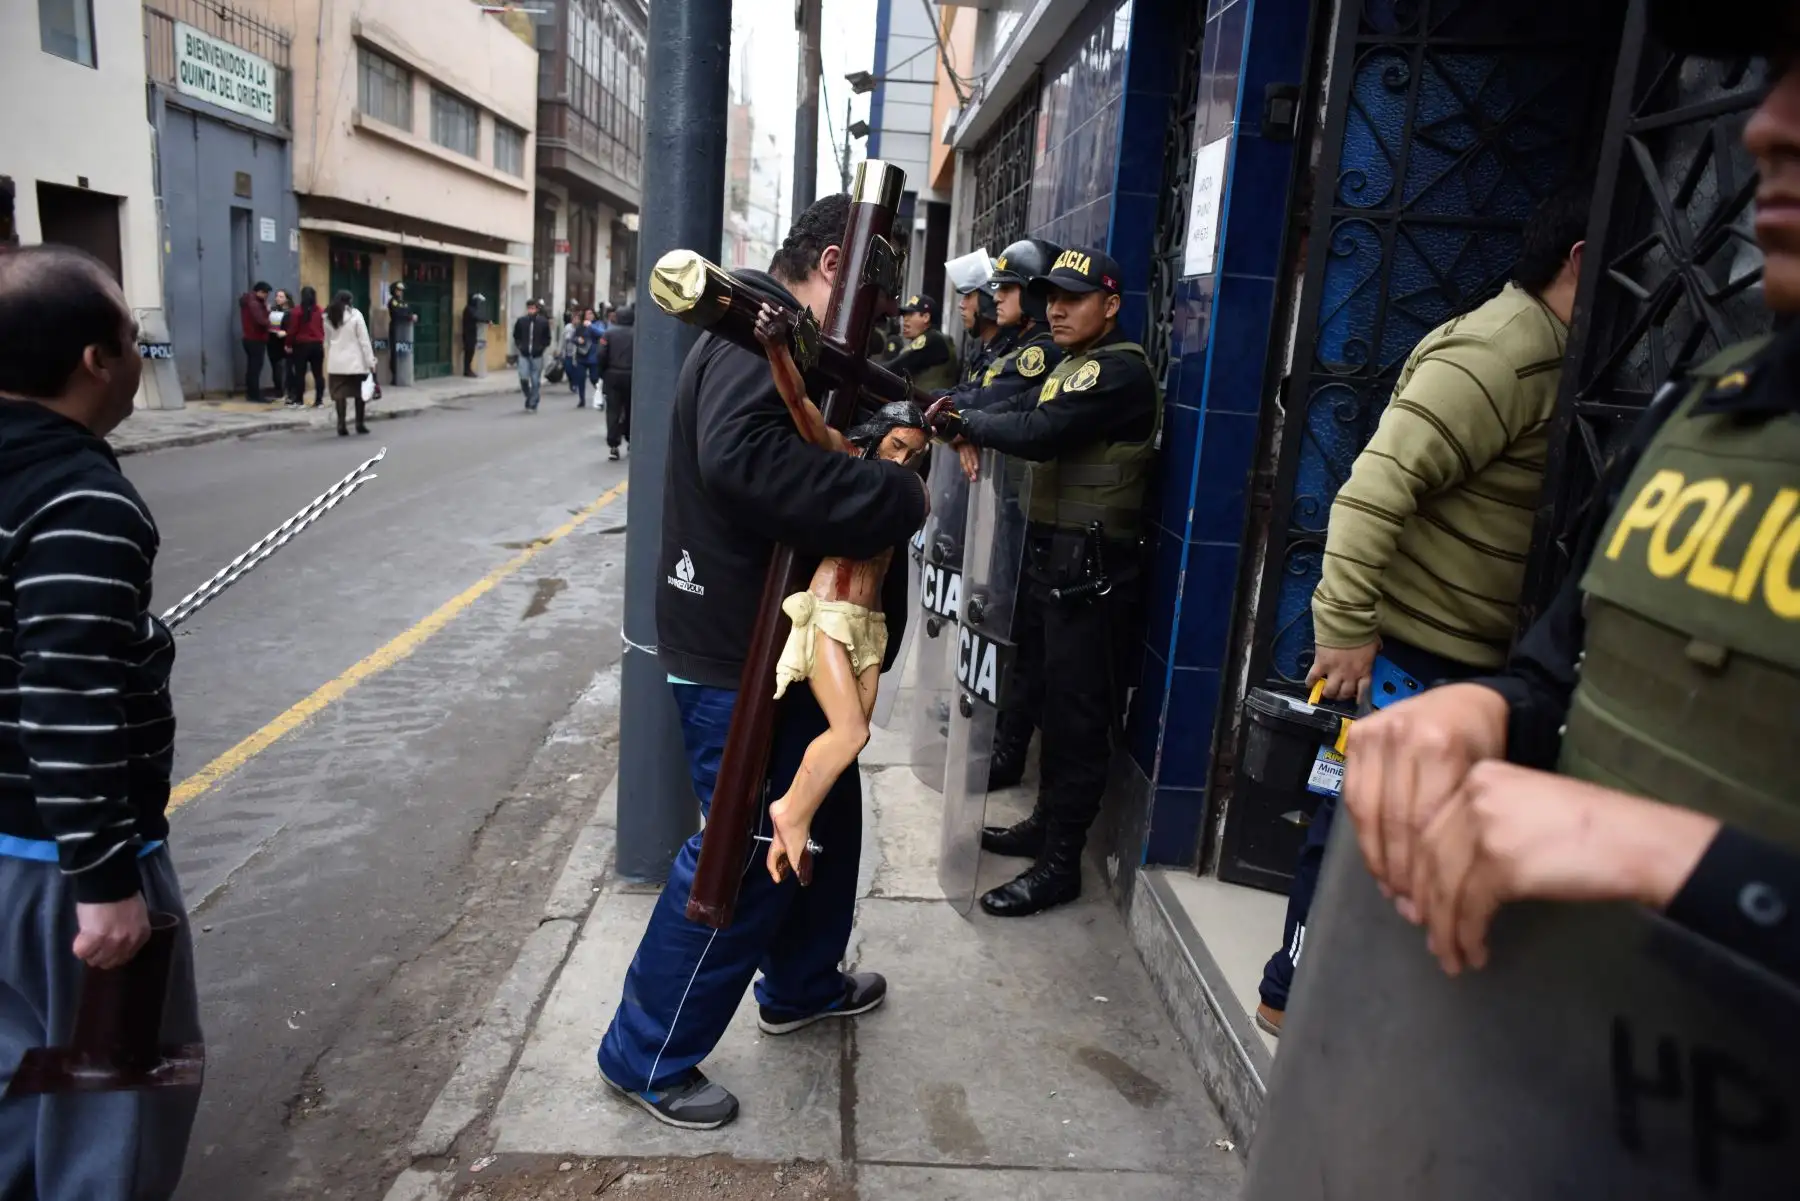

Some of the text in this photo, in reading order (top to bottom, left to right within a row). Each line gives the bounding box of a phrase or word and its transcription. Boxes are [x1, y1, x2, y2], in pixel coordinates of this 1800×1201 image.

[180, 60, 272, 113] QUINTA DEL ORIENTE
[186, 33, 267, 88] BIENVENIDOS A LA
[957, 626, 997, 704] CIA
